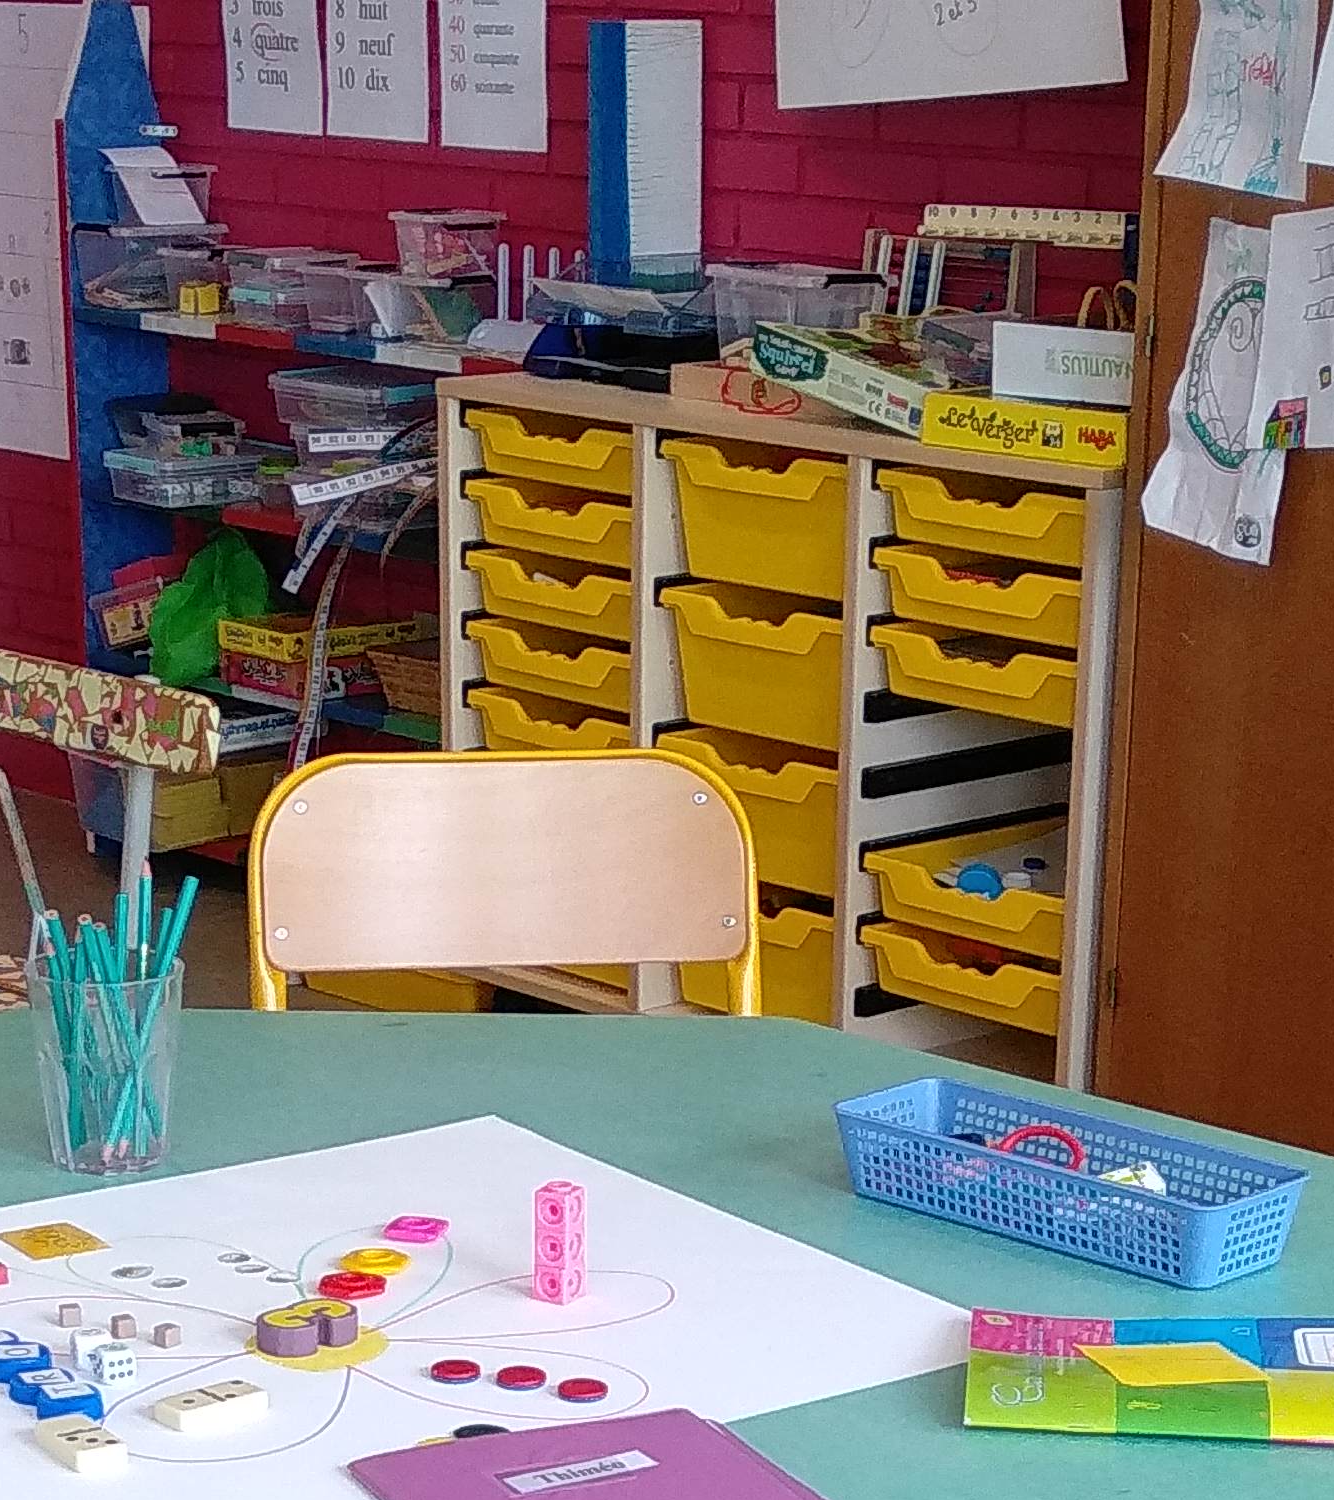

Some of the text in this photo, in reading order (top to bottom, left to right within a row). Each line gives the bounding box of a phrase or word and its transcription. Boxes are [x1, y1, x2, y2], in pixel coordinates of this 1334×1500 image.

[358, 0, 388, 20] huit
[232, 27, 299, 57] 4 quatre
[335, 31, 396, 57] 9 neuf
[236, 61, 289, 92] 5 cinq
[338, 66, 391, 92] 10 dix
[944, 407, 970, 427] Le
[1077, 426, 1117, 451] HABA
